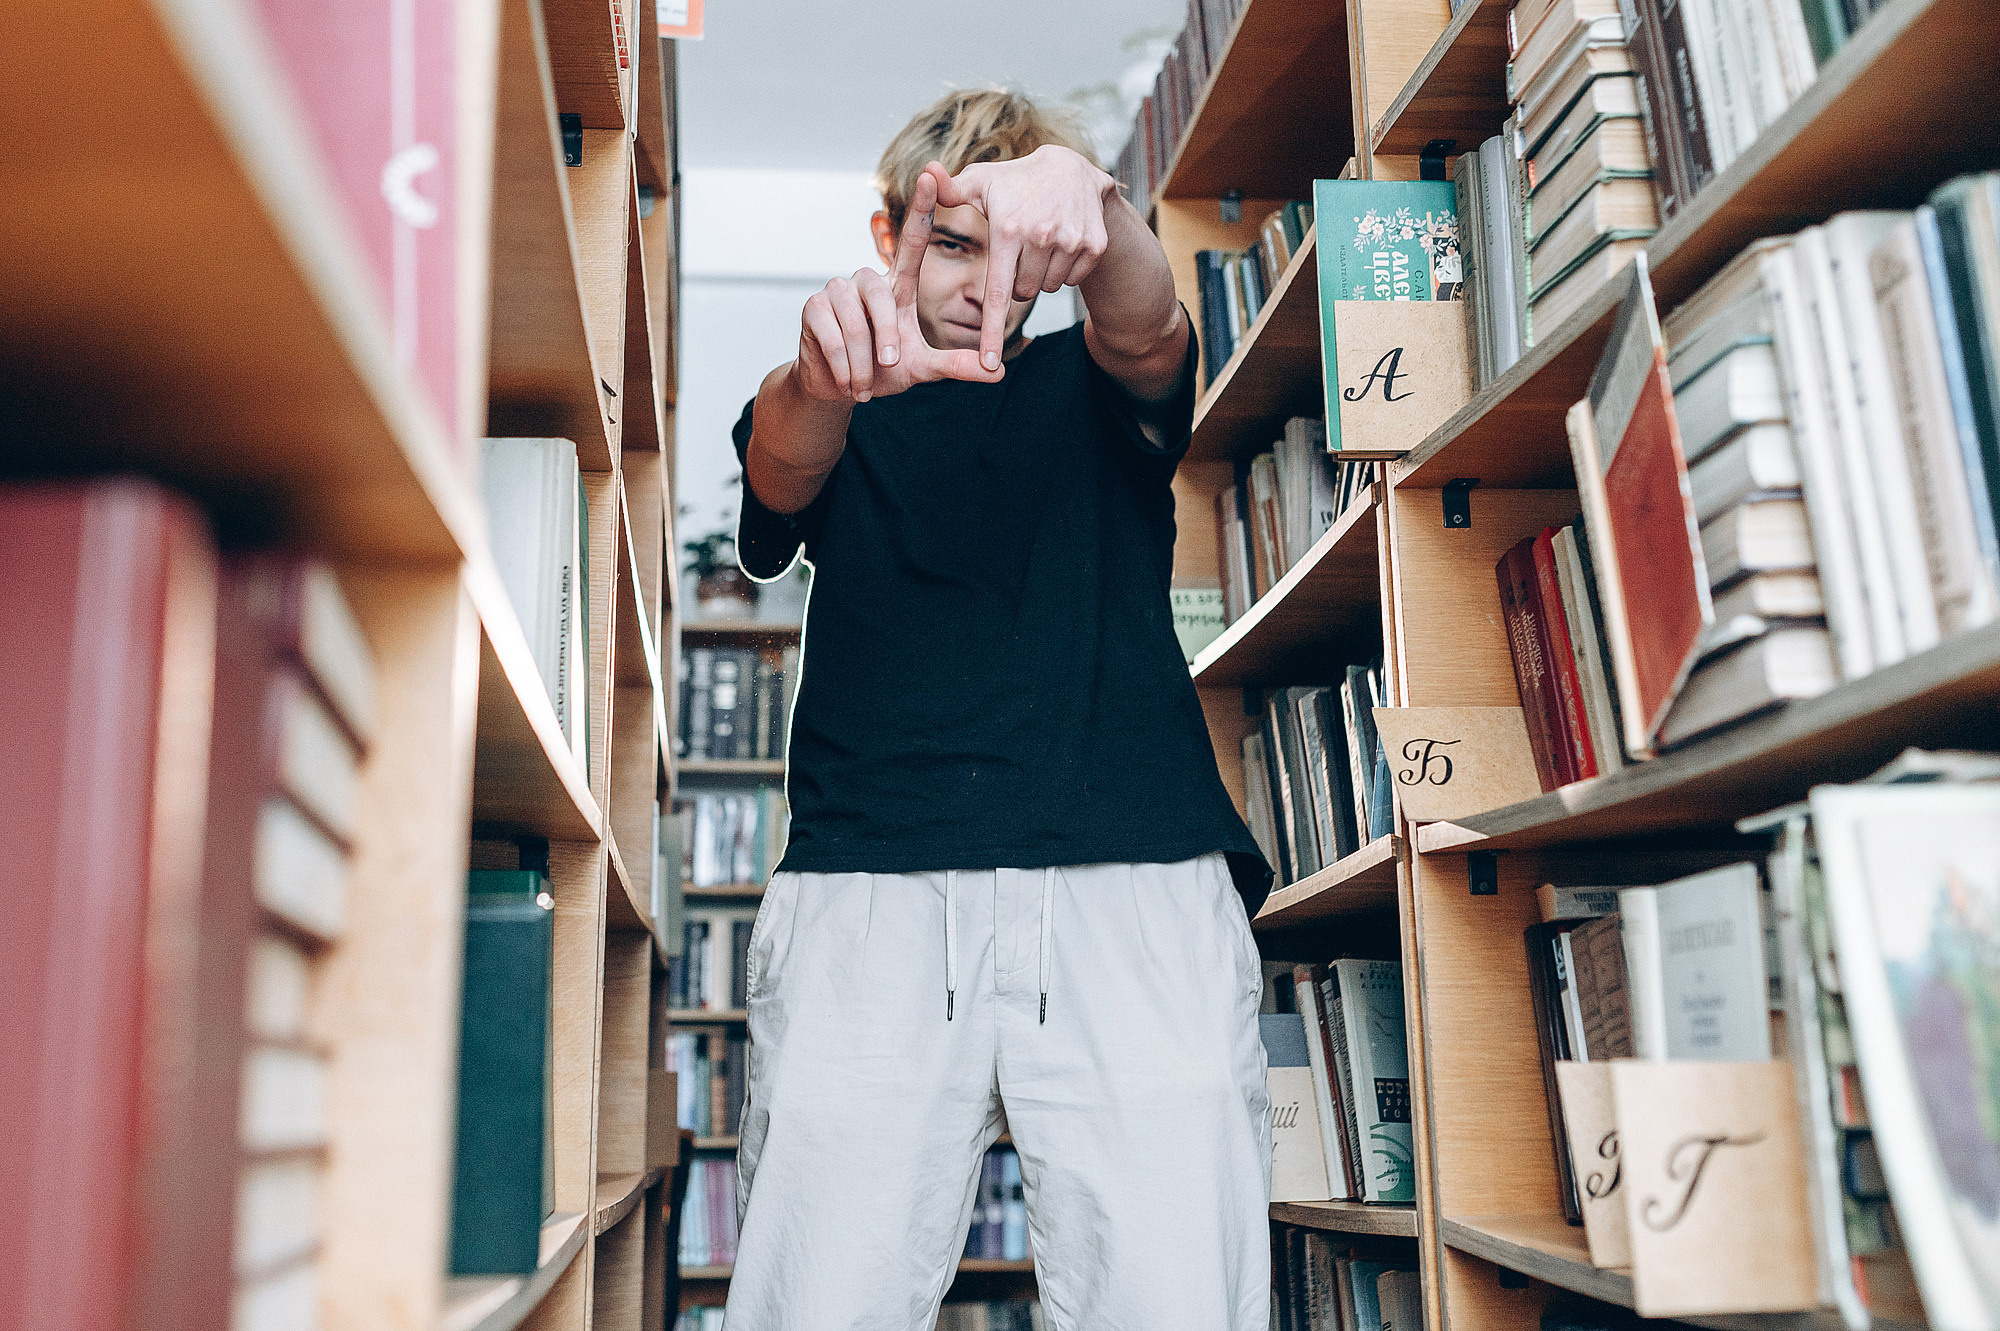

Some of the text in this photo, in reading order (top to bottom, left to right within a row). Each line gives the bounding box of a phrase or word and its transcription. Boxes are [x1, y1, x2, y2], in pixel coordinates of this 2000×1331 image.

[1363, 251, 1392, 301] ЦВЕ
[1343, 347, 1415, 402] А
[1398, 737, 1461, 786] Б
